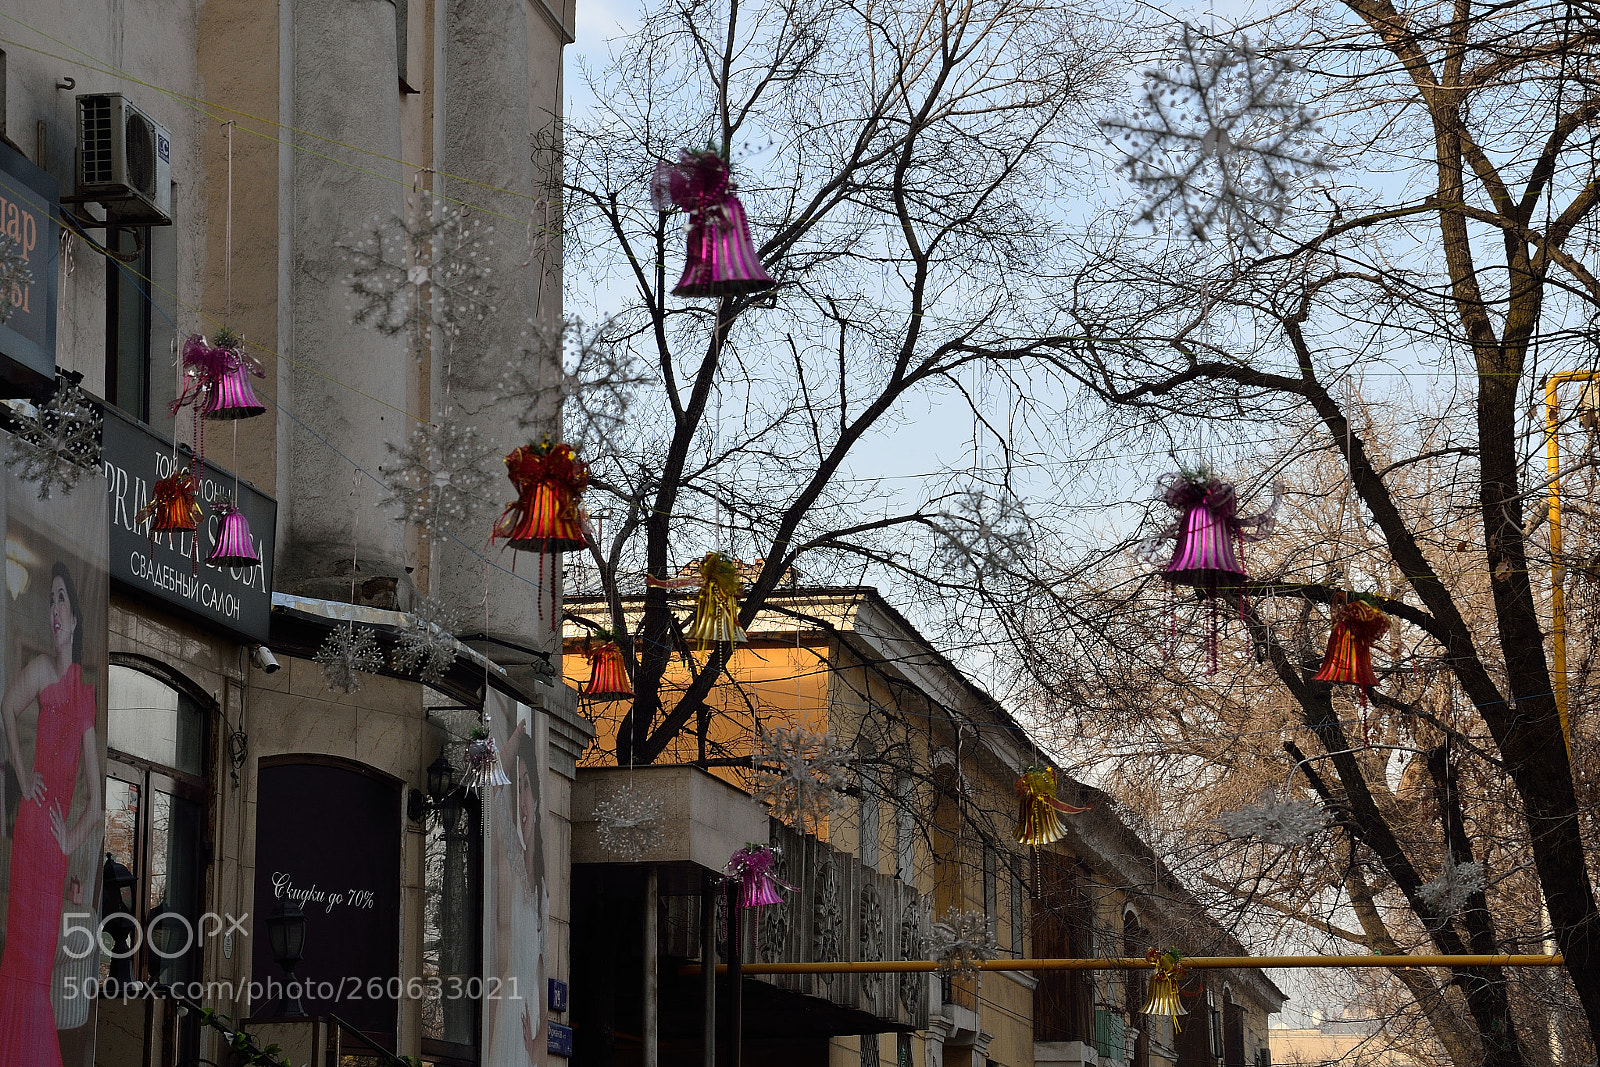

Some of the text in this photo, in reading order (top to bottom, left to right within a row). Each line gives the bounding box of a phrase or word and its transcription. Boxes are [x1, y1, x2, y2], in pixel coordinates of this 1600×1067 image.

[130, 551, 199, 603] СВАДЕБНЫЙ
[201, 583, 240, 620] САЛОН
[271, 871, 375, 914] Скидки до 70%
